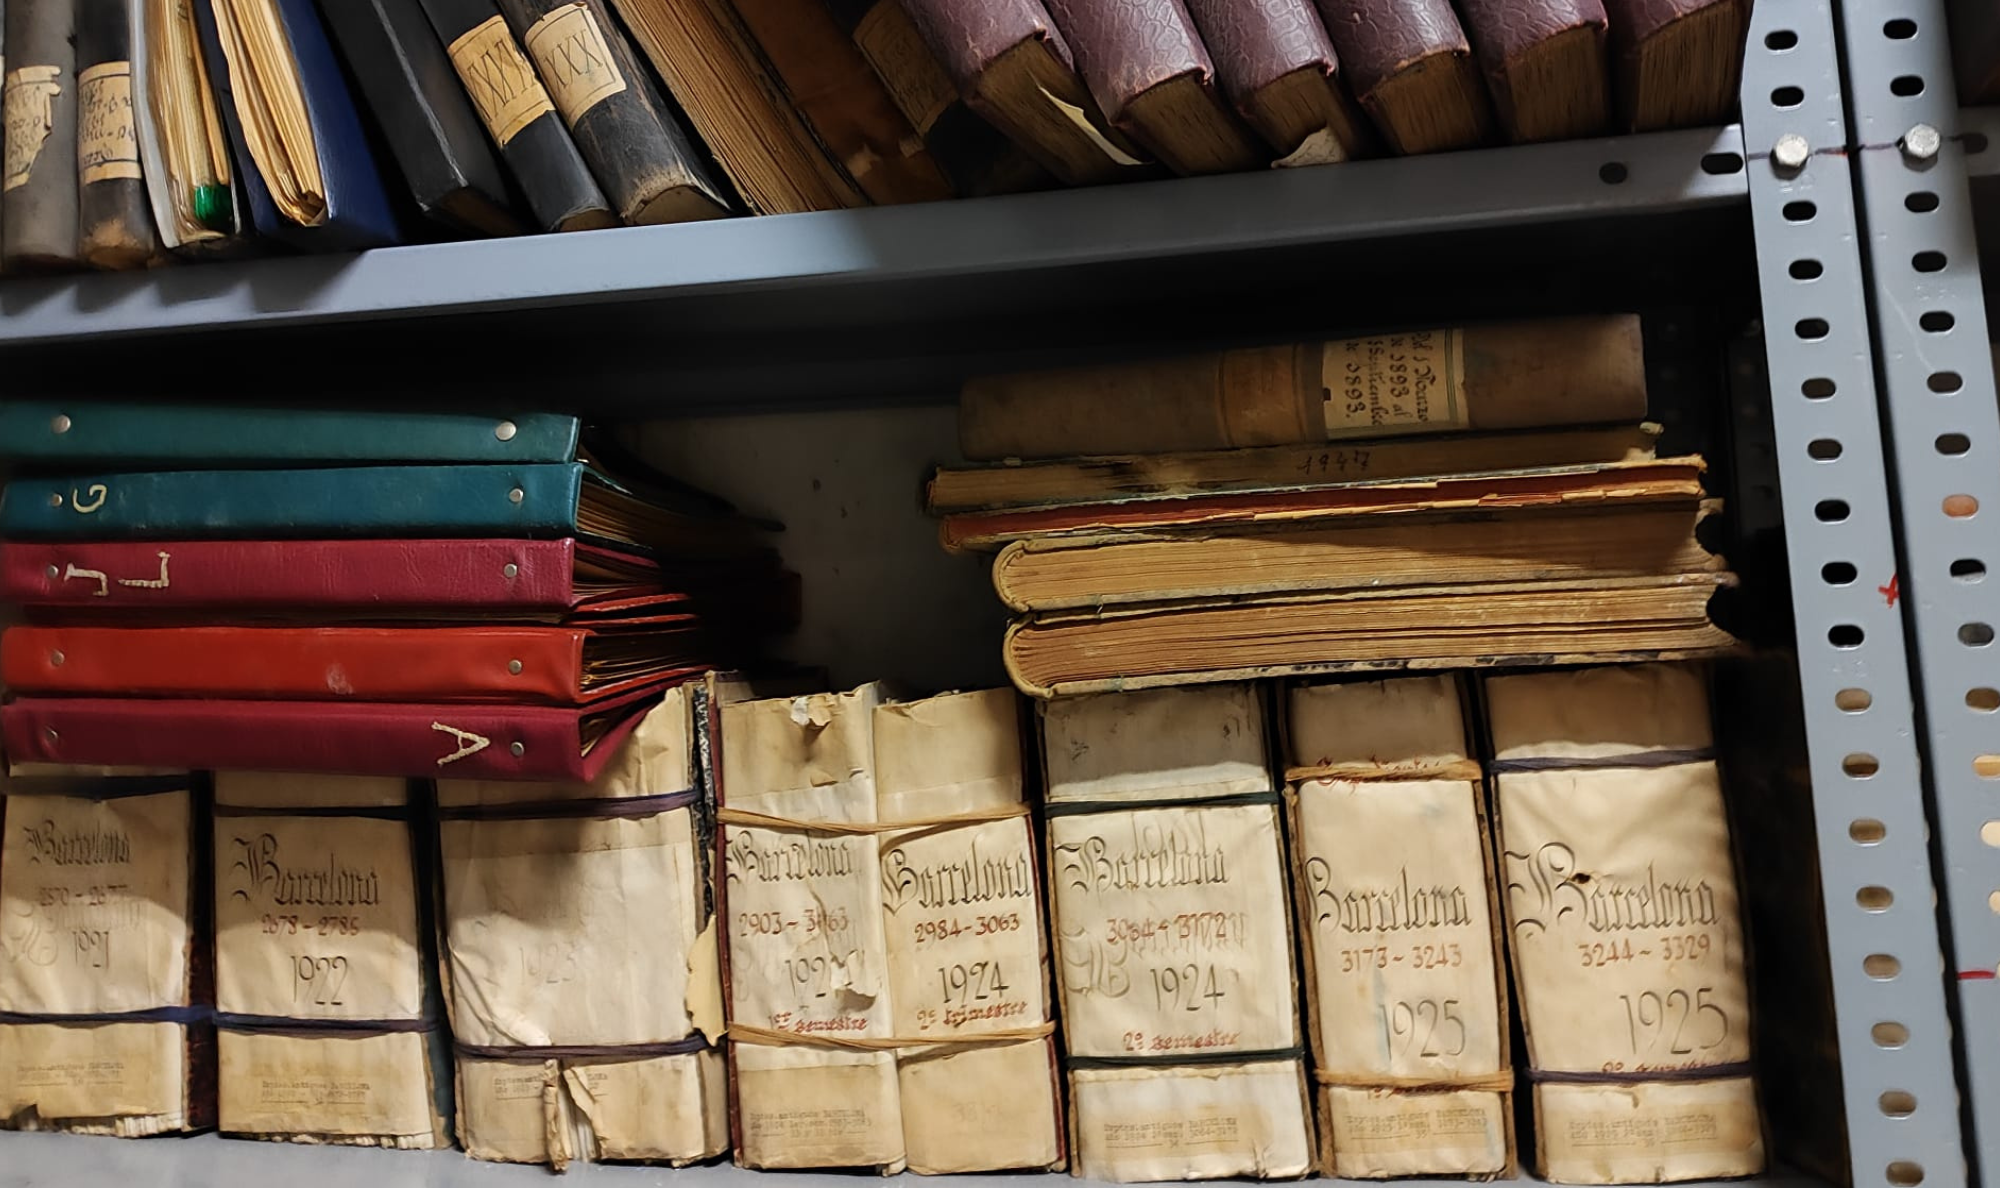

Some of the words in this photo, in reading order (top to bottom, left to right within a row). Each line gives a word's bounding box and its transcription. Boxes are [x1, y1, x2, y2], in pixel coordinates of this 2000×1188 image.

[72, 483, 107, 513] G
[431, 720, 491, 766] A
[1304, 856, 1473, 935] Barcelona
[1502, 841, 1720, 934] Barcelona
[290, 955, 349, 1006] 1922
[938, 960, 1010, 1004] 1924
[1149, 962, 1226, 1012] 1924
[1378, 998, 1467, 1062] 1925
[1618, 987, 1729, 1055] 1925
